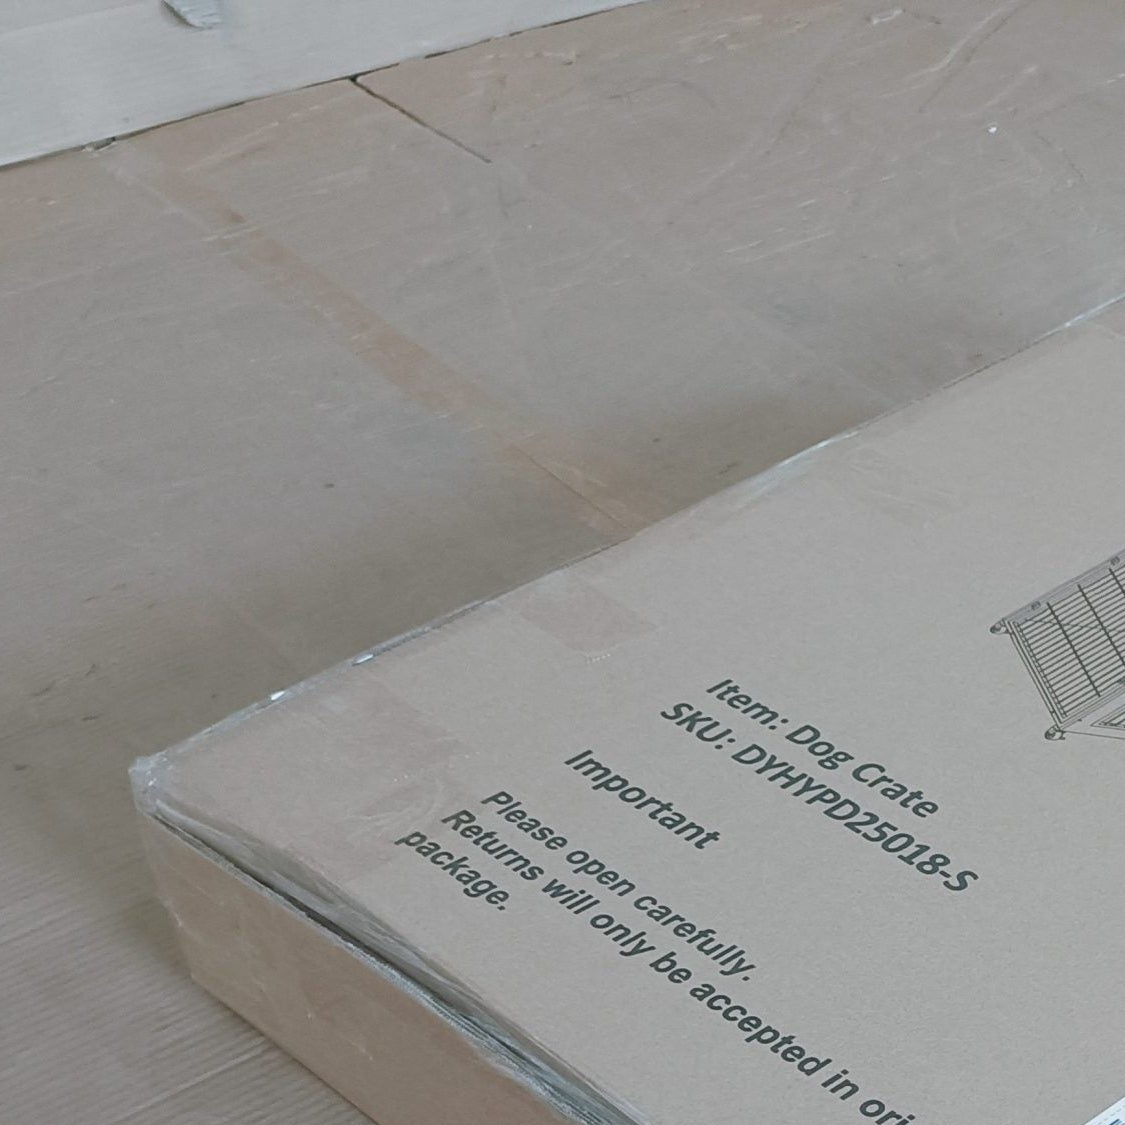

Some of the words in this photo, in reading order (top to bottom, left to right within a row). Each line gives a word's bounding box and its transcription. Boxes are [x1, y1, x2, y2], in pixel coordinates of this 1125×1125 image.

[563, 748, 721, 850] Important
[660, 701, 736, 750] SKU:
[731, 743, 978, 892] DYHYPD25018-S
[705, 678, 788, 731] Item:
[785, 724, 854, 771] Dog
[851, 761, 939, 819] Crate
[394, 828, 509, 911] package.
[481, 791, 568, 852] Please
[566, 844, 635, 898] open
[632, 895, 757, 982] carefully.
[441, 808, 545, 883] Returns
[542, 879, 597, 915] will
[590, 911, 655, 959] only
[650, 951, 692, 984] be
[689, 978, 833, 1077] accepted
[820, 1069, 860, 1101] in
